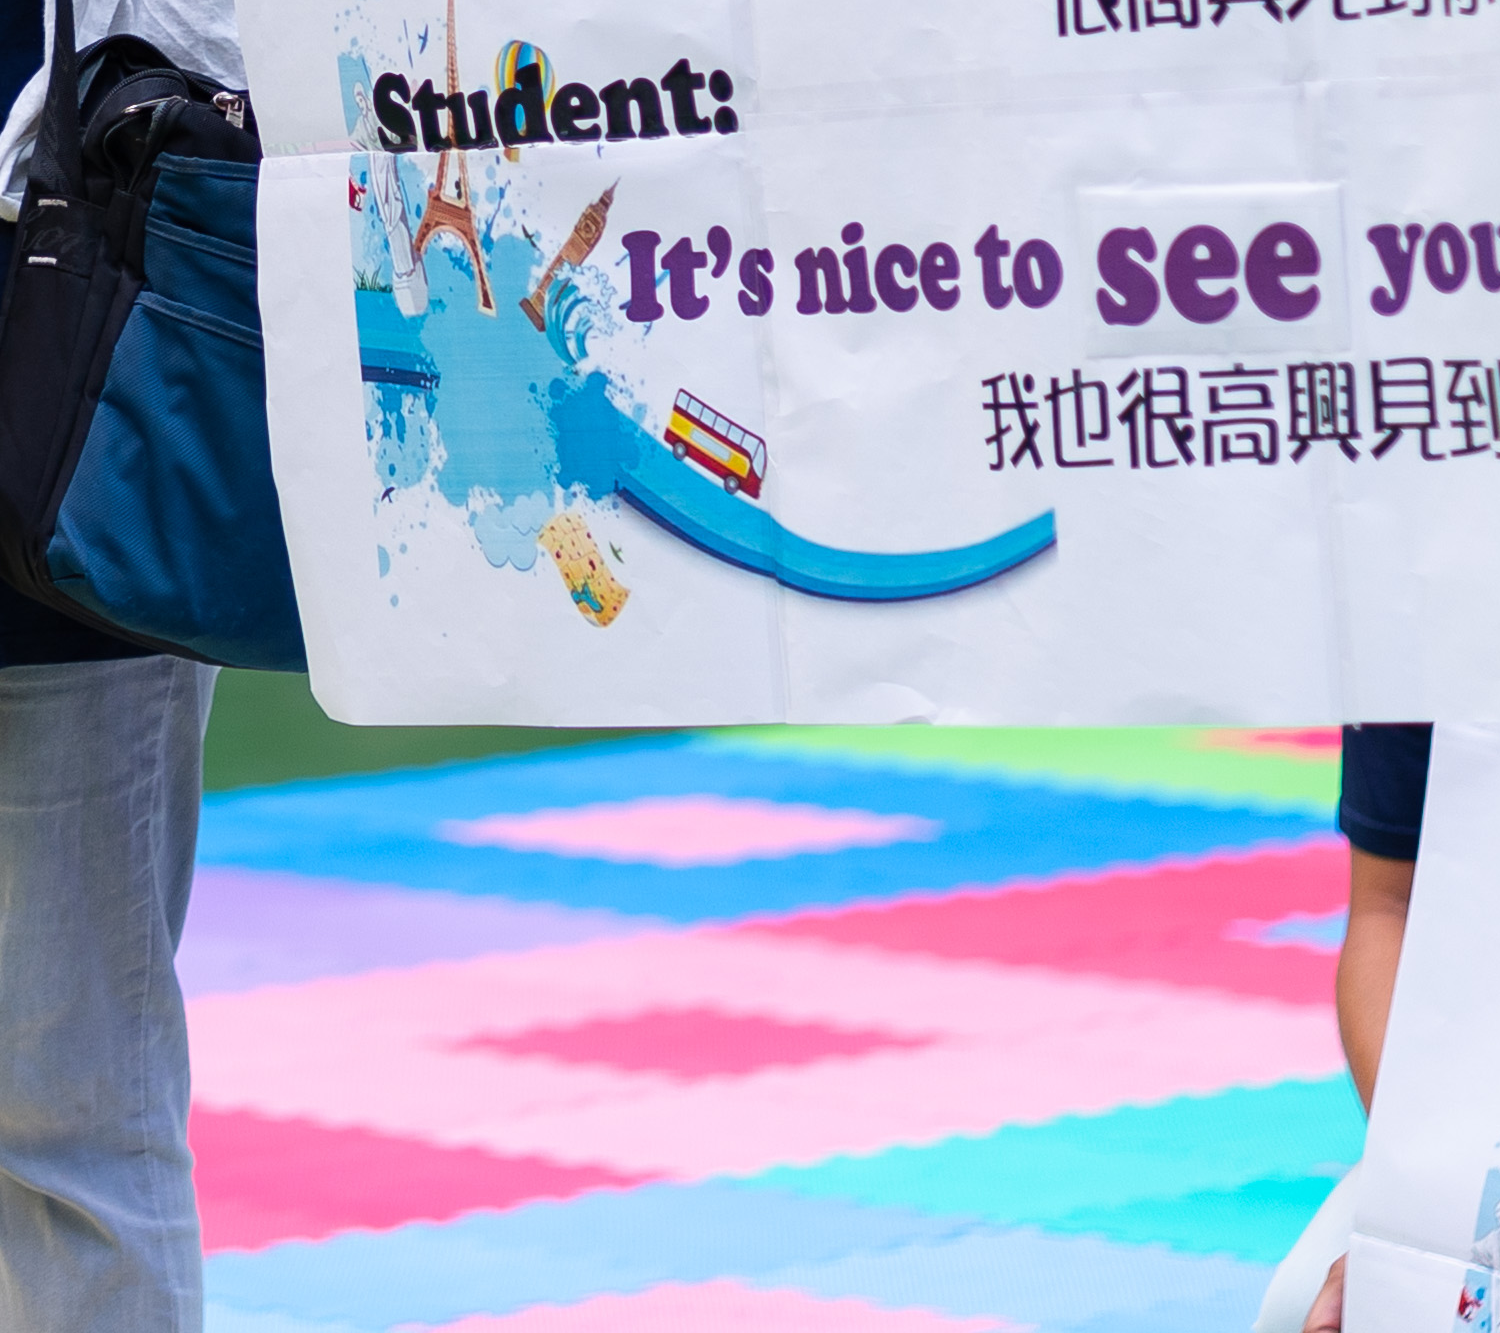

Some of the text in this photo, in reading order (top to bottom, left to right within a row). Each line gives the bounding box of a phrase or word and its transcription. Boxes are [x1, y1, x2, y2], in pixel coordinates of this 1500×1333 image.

[373, 60, 739, 155] Student:
[622, 226, 774, 321] It's
[795, 222, 960, 315] nice
[975, 225, 1063, 309] to
[1097, 222, 1320, 325] see
